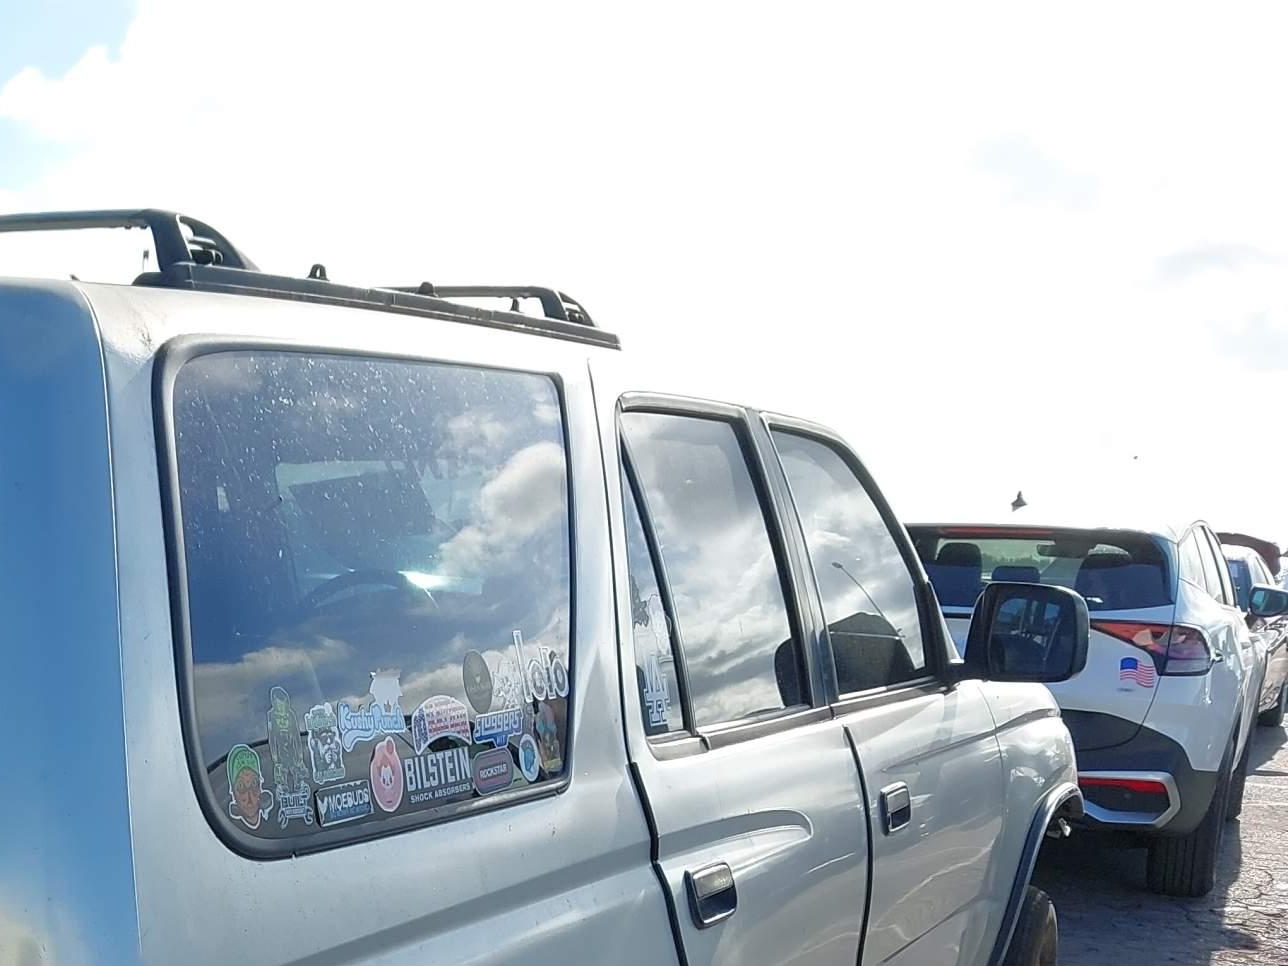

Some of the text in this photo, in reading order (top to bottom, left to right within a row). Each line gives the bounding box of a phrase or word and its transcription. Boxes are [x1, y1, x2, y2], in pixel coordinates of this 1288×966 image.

[371, 703, 405, 733] Punch
[404, 746, 471, 791] BILSTEIN
[480, 763, 508, 779] ROCKSTAR
[410, 782, 471, 804] SHOCK ABSORBERS
